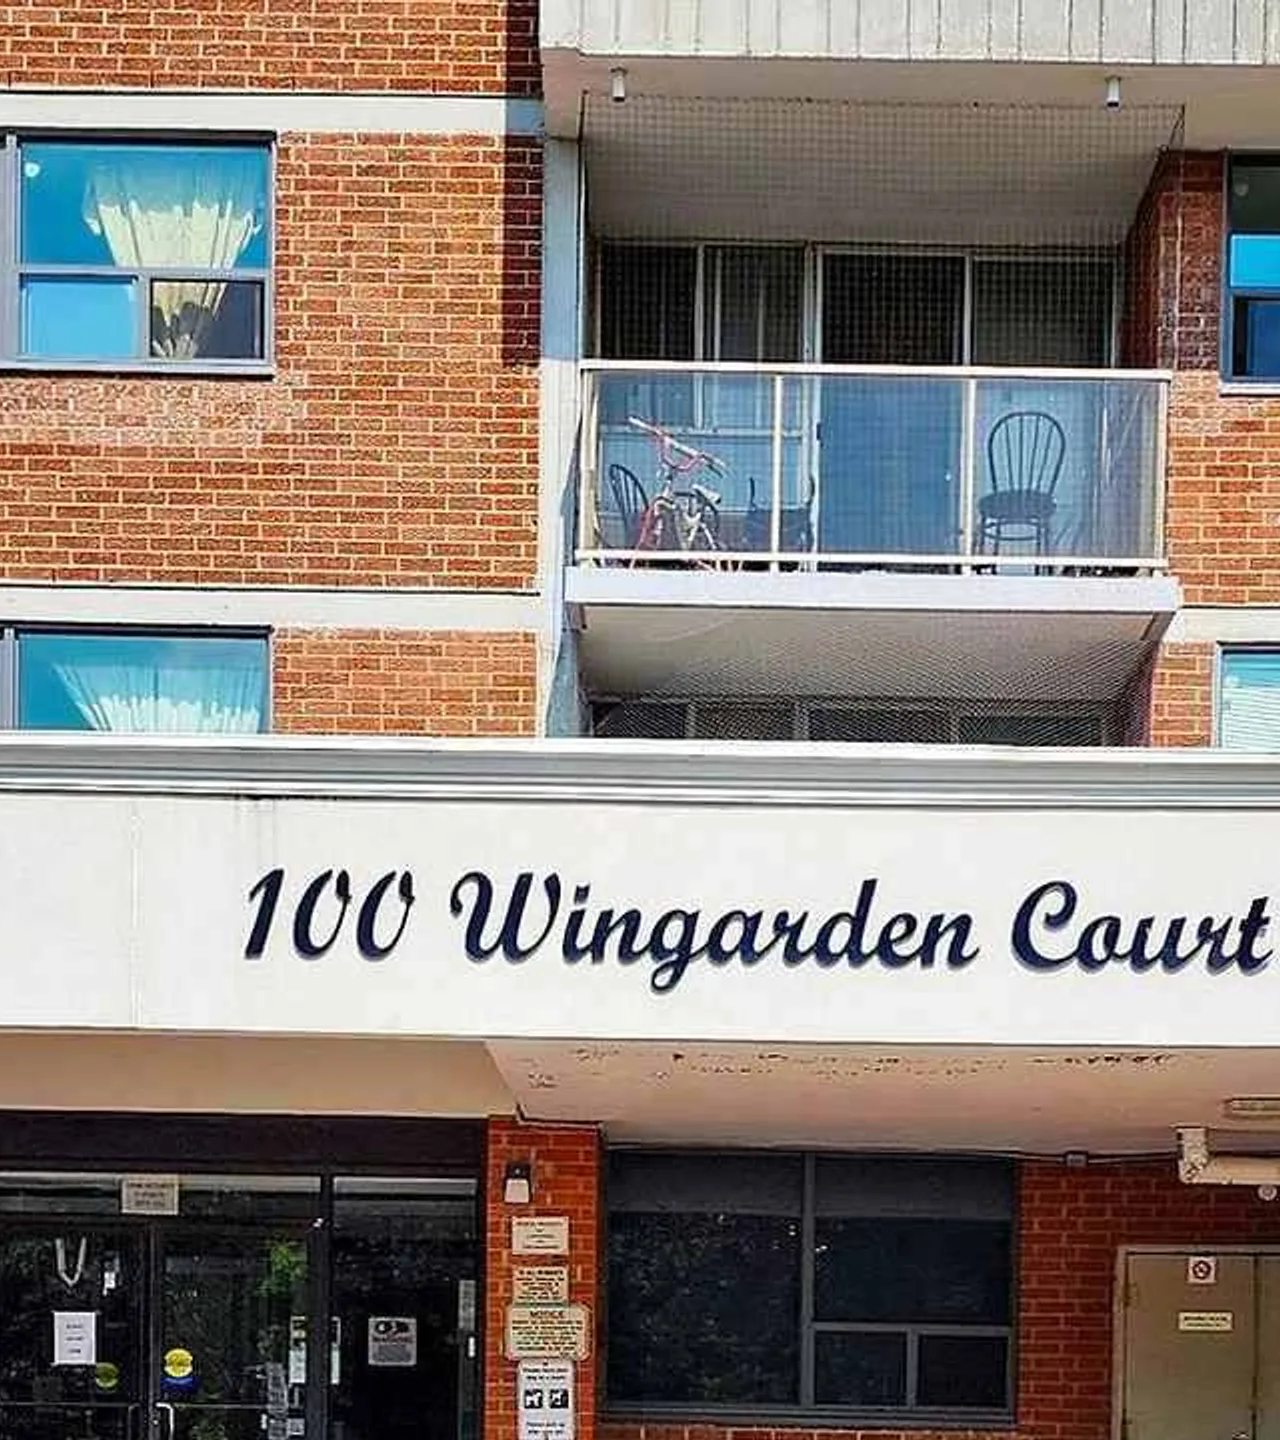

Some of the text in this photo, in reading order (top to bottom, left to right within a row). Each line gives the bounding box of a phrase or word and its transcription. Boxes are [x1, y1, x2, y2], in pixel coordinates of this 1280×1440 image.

[245, 868, 1274, 994] 100 Wingarden Court
